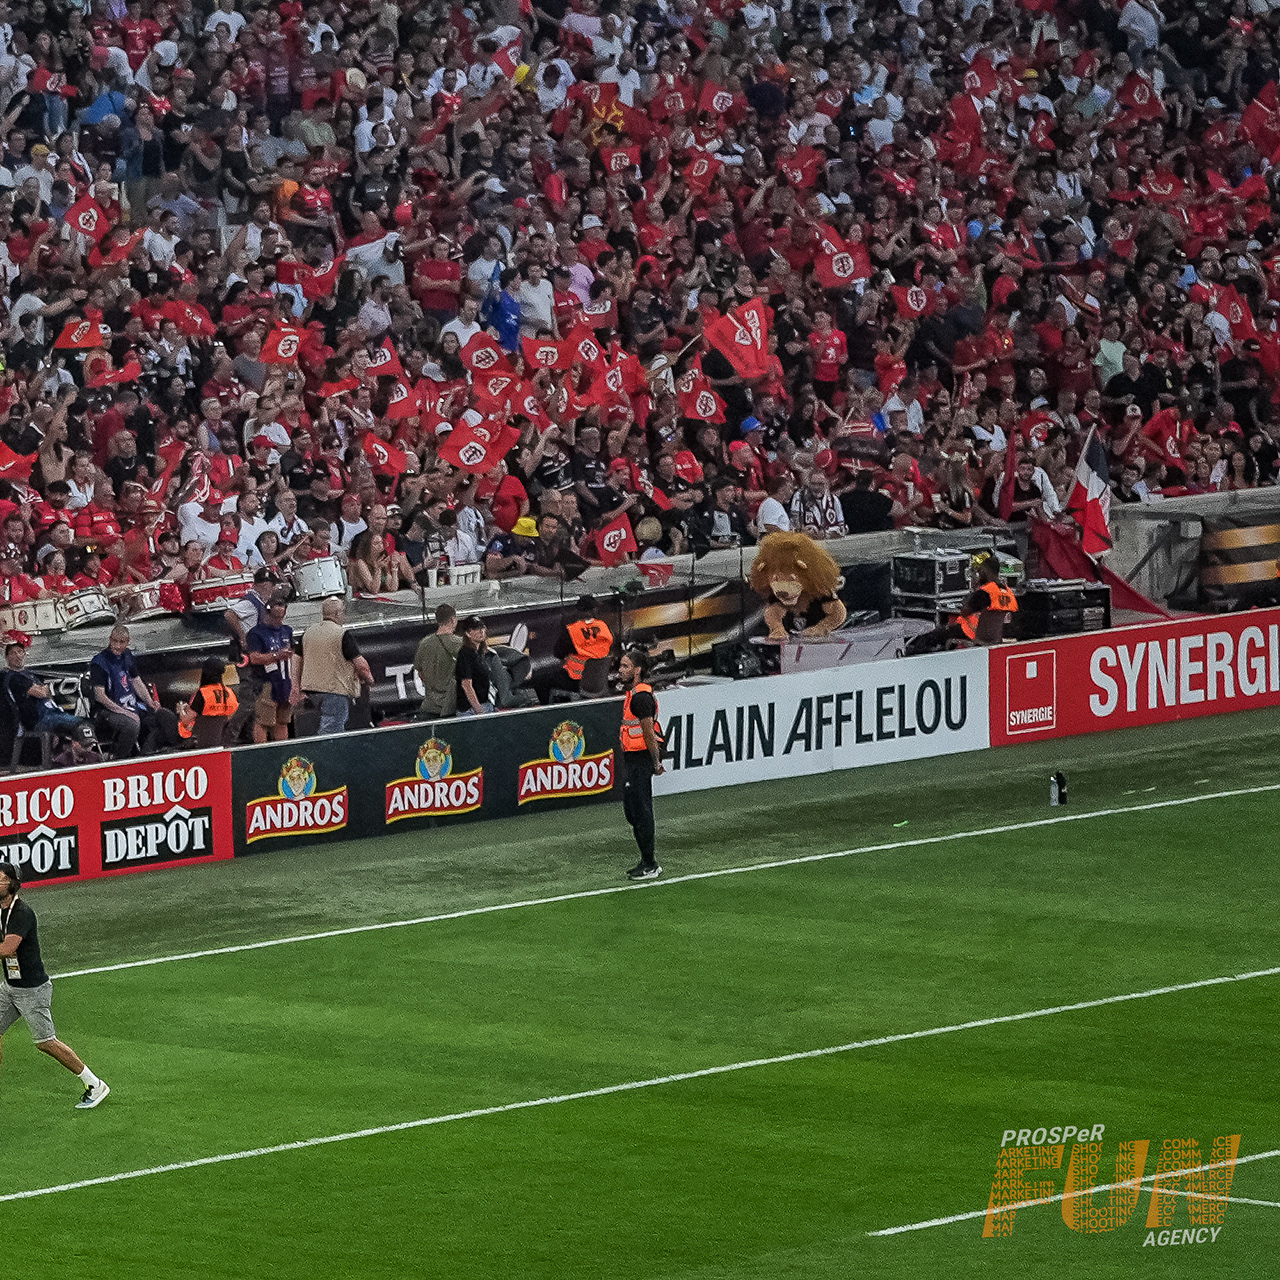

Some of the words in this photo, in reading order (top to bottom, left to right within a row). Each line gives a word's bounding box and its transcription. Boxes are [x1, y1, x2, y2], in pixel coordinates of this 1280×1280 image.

[43, 676, 81, 696] TO
[661, 701, 776, 770] ALAIN
[782, 675, 967, 756] AFFLELOU
[1009, 706, 1053, 726] SYNERGIE
[102, 765, 209, 813] BRICO
[387, 776, 481, 815] ANDROS
[520, 758, 611, 797] ANDROS
[103, 804, 209, 863] DEPÔT
[248, 793, 345, 834] ANDROS
